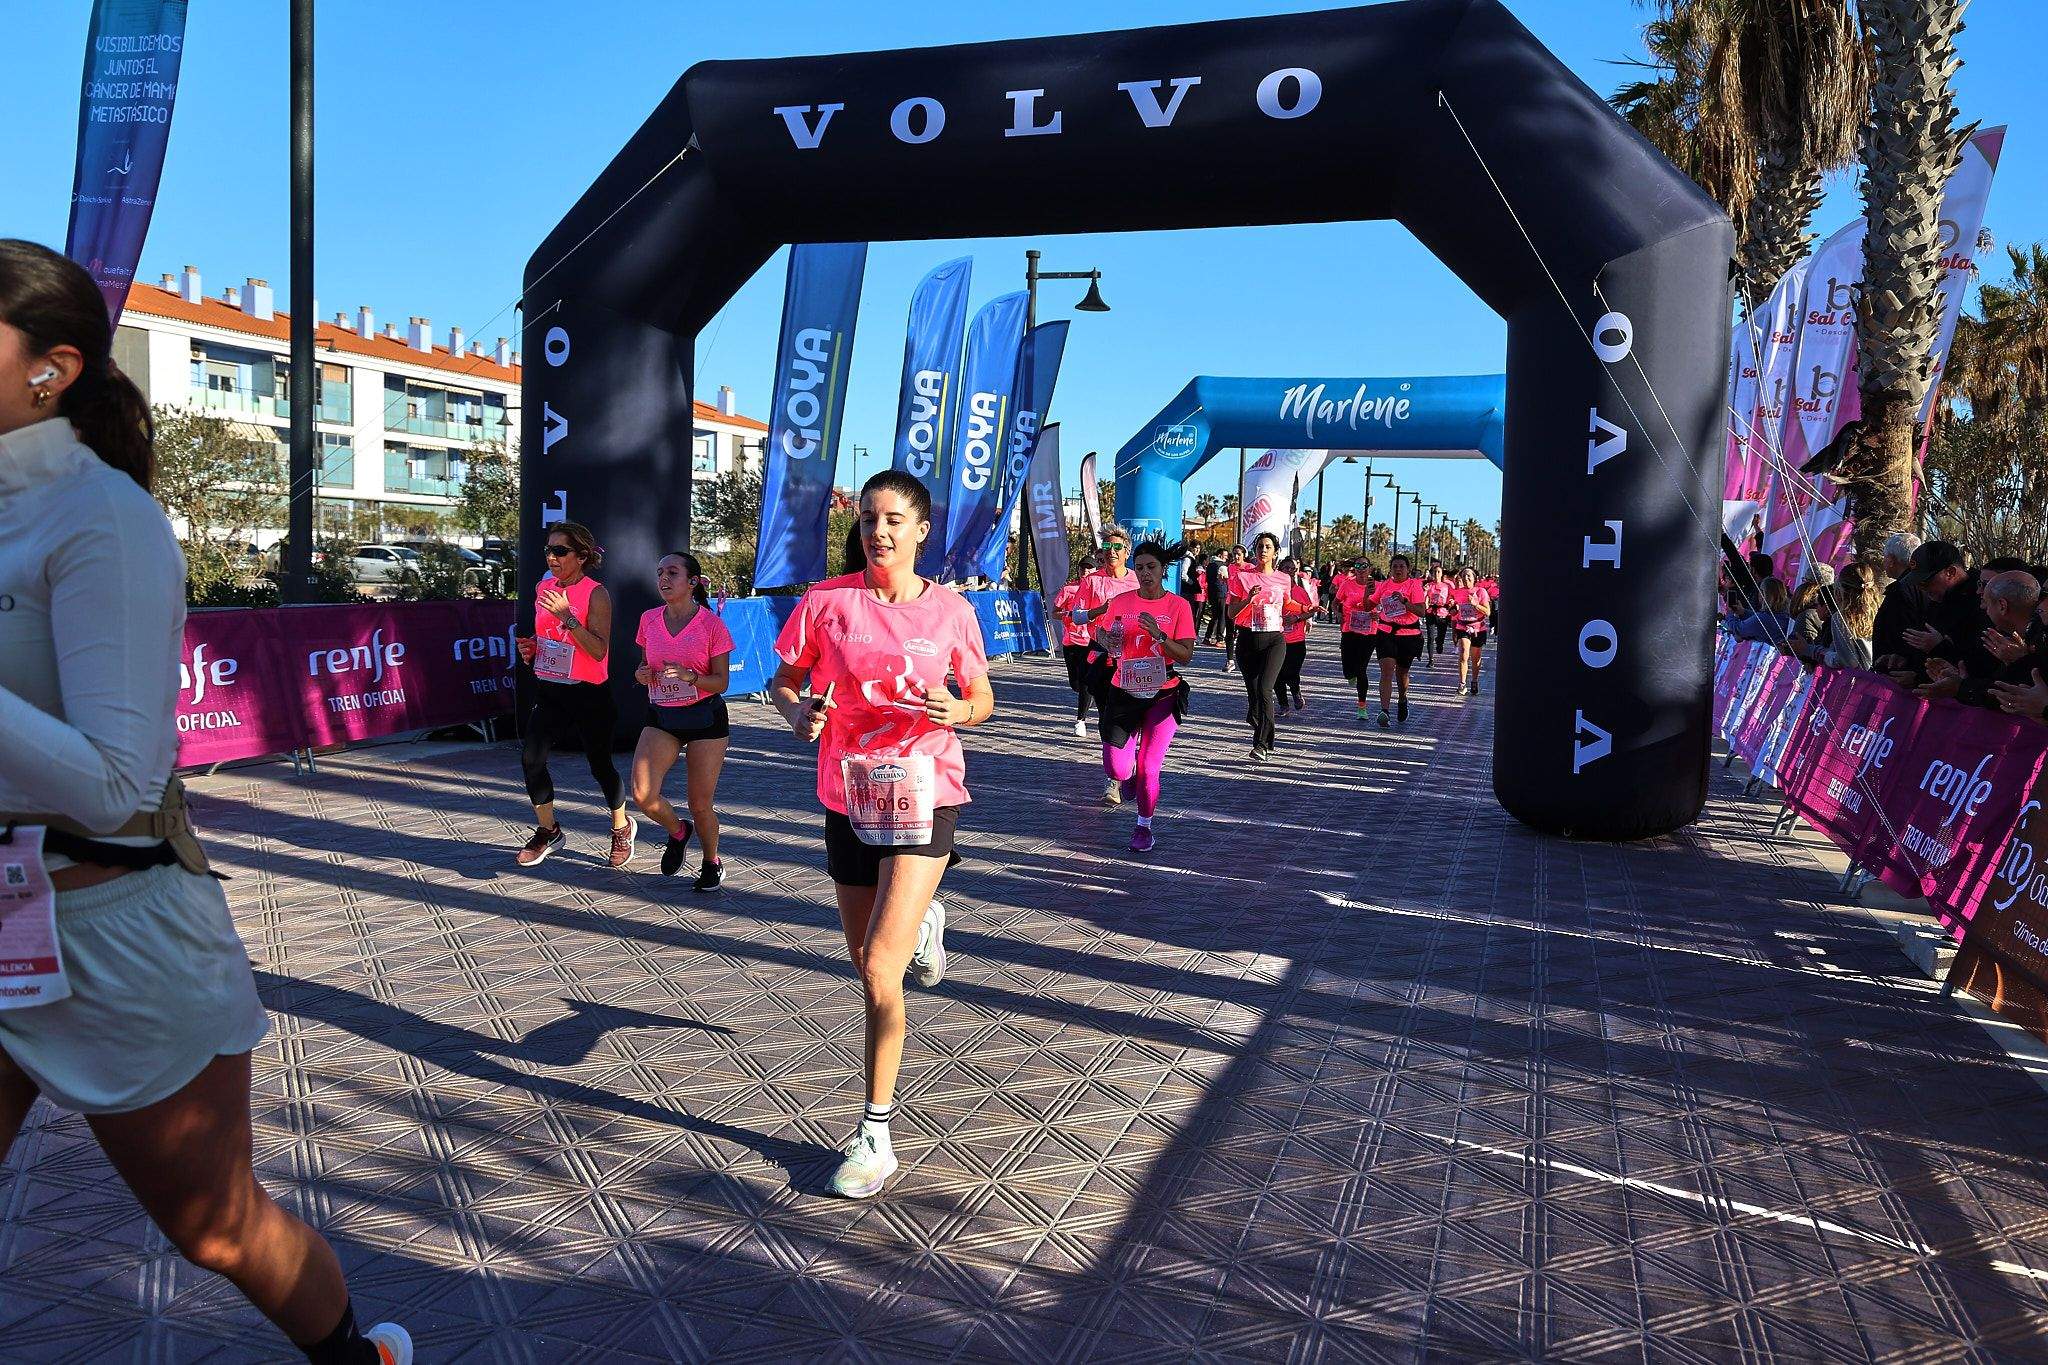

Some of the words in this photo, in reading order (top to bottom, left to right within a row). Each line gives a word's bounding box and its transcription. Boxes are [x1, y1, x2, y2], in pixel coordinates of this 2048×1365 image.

[95, 34, 182, 53] VISIBILICEMOS
[104, 59, 146, 76] JUNTOS
[145, 57, 159, 75] EL
[84, 79, 129, 99] CÁNCER
[129, 82, 143, 99] DE
[774, 67, 1322, 149] VOLVO
[90, 101, 168, 124] METASTÁSICO
[1807, 311, 1837, 326] Sal
[782, 327, 832, 460] GOYA
[1280, 383, 1411, 440] Marlene
[905, 370, 942, 478] GOYA
[961, 391, 997, 491] GOYA
[1157, 432, 1195, 450] Marlene
[1033, 480, 1059, 539] IMR
[1574, 311, 1634, 774] VOLVO
[308, 628, 405, 683] renfe
[453, 623, 517, 670] renf
[1135, 675, 1153, 684] 016
[176, 710, 241, 732] OFICIAL
[328, 695, 361, 713] TREN
[1841, 716, 1895, 778] renfe
[877, 797, 909, 811] 016
[1919, 754, 1994, 827] renfe
[1901, 823, 1925, 852] TREN
